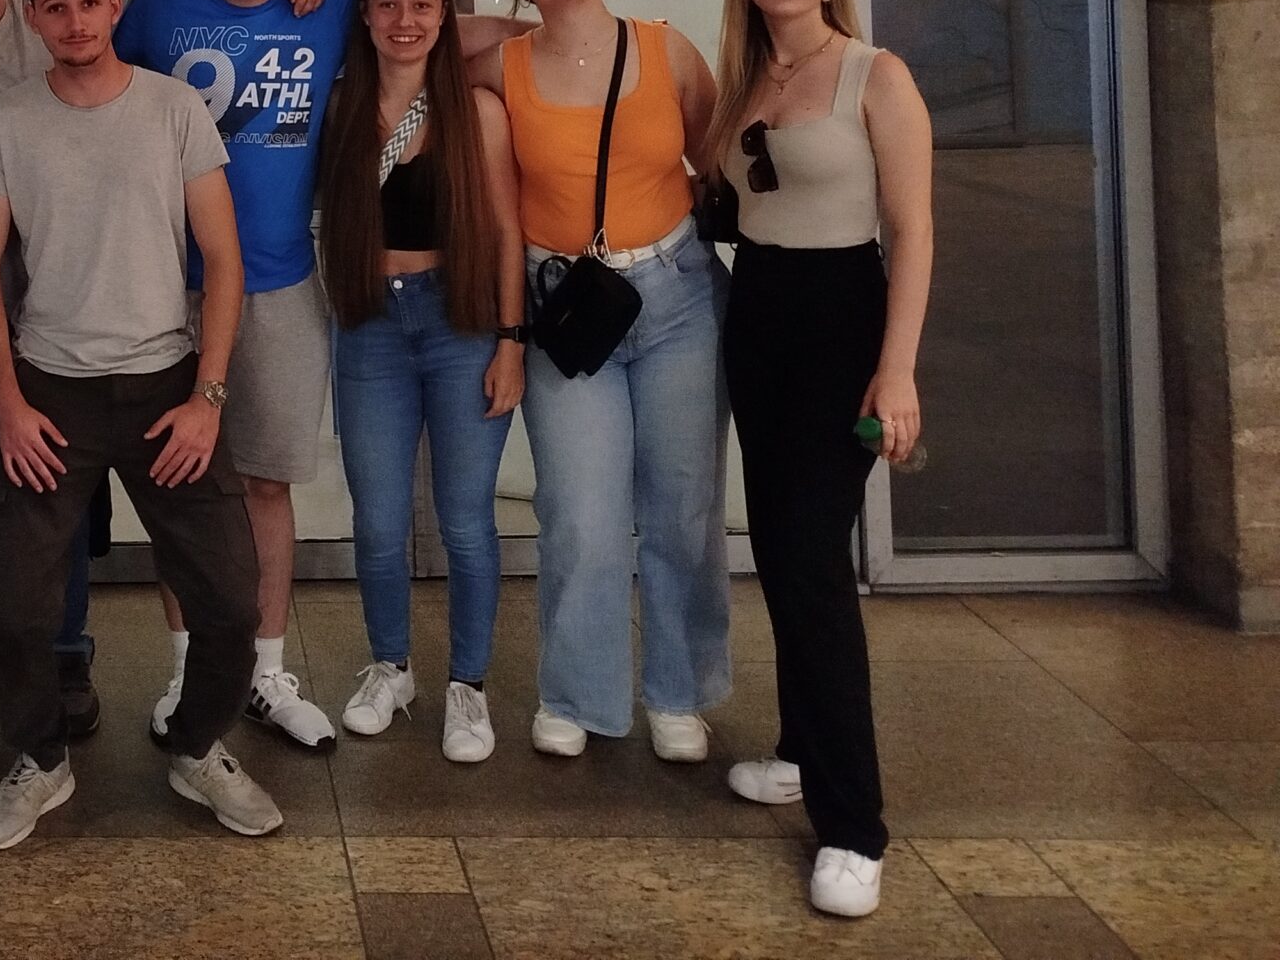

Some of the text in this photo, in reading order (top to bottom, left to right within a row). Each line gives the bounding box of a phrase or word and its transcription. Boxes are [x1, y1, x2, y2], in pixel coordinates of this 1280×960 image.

[169, 25, 249, 57] NYC
[255, 47, 316, 80] 4.2
[235, 82, 312, 108] ATHL
[276, 111, 309, 124] DEPT.
